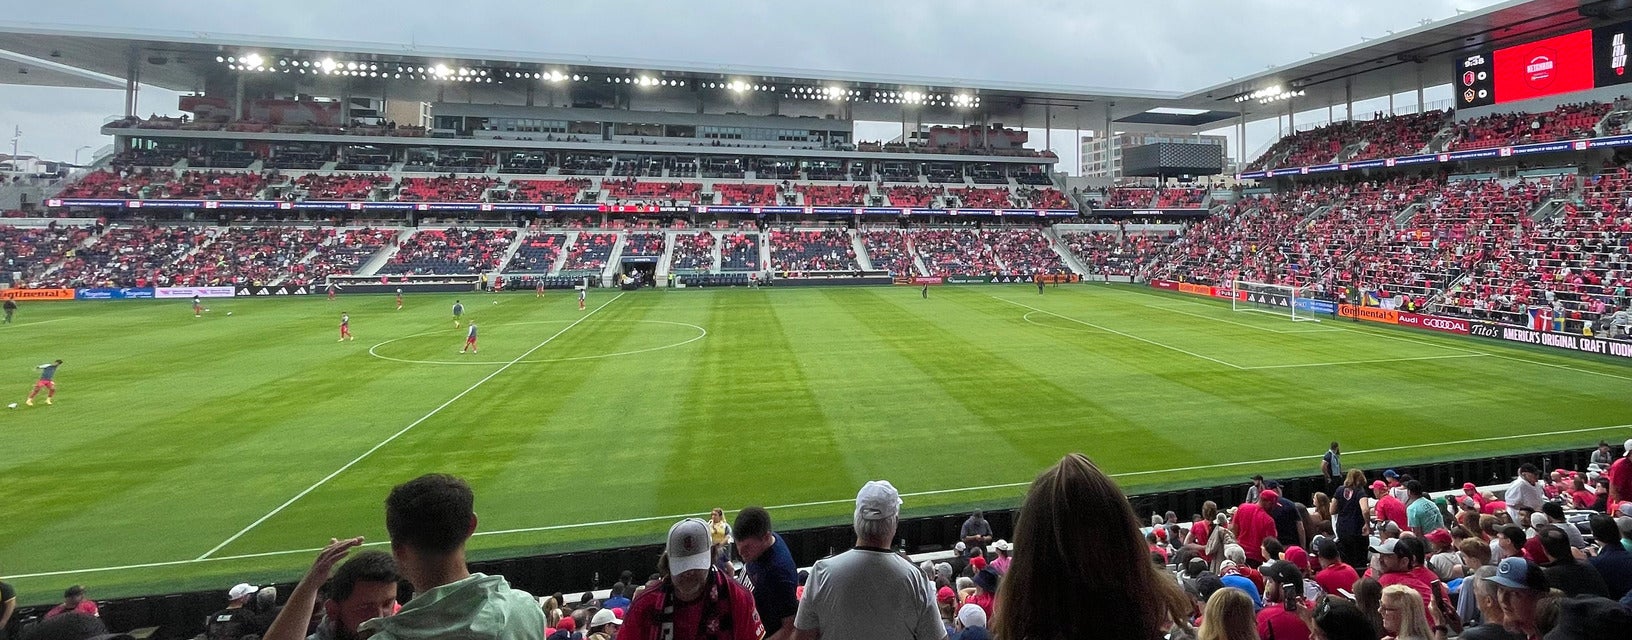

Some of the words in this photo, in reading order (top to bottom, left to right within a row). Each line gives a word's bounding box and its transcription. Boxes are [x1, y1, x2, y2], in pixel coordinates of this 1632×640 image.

[1613, 33, 1624, 46] ALL
[1612, 55, 1627, 68] CITY
[1478, 71, 1487, 80] 0
[1478, 89, 1488, 98] 0
[1221, 289, 1240, 297] PURIA
[1399, 315, 1418, 324] Audi
[1471, 324, 1499, 337] Tito's
[1503, 328, 1540, 344] AMERICA'S
[1541, 332, 1578, 350] ORIGINAL
[1580, 337, 1607, 354] CRAFT
